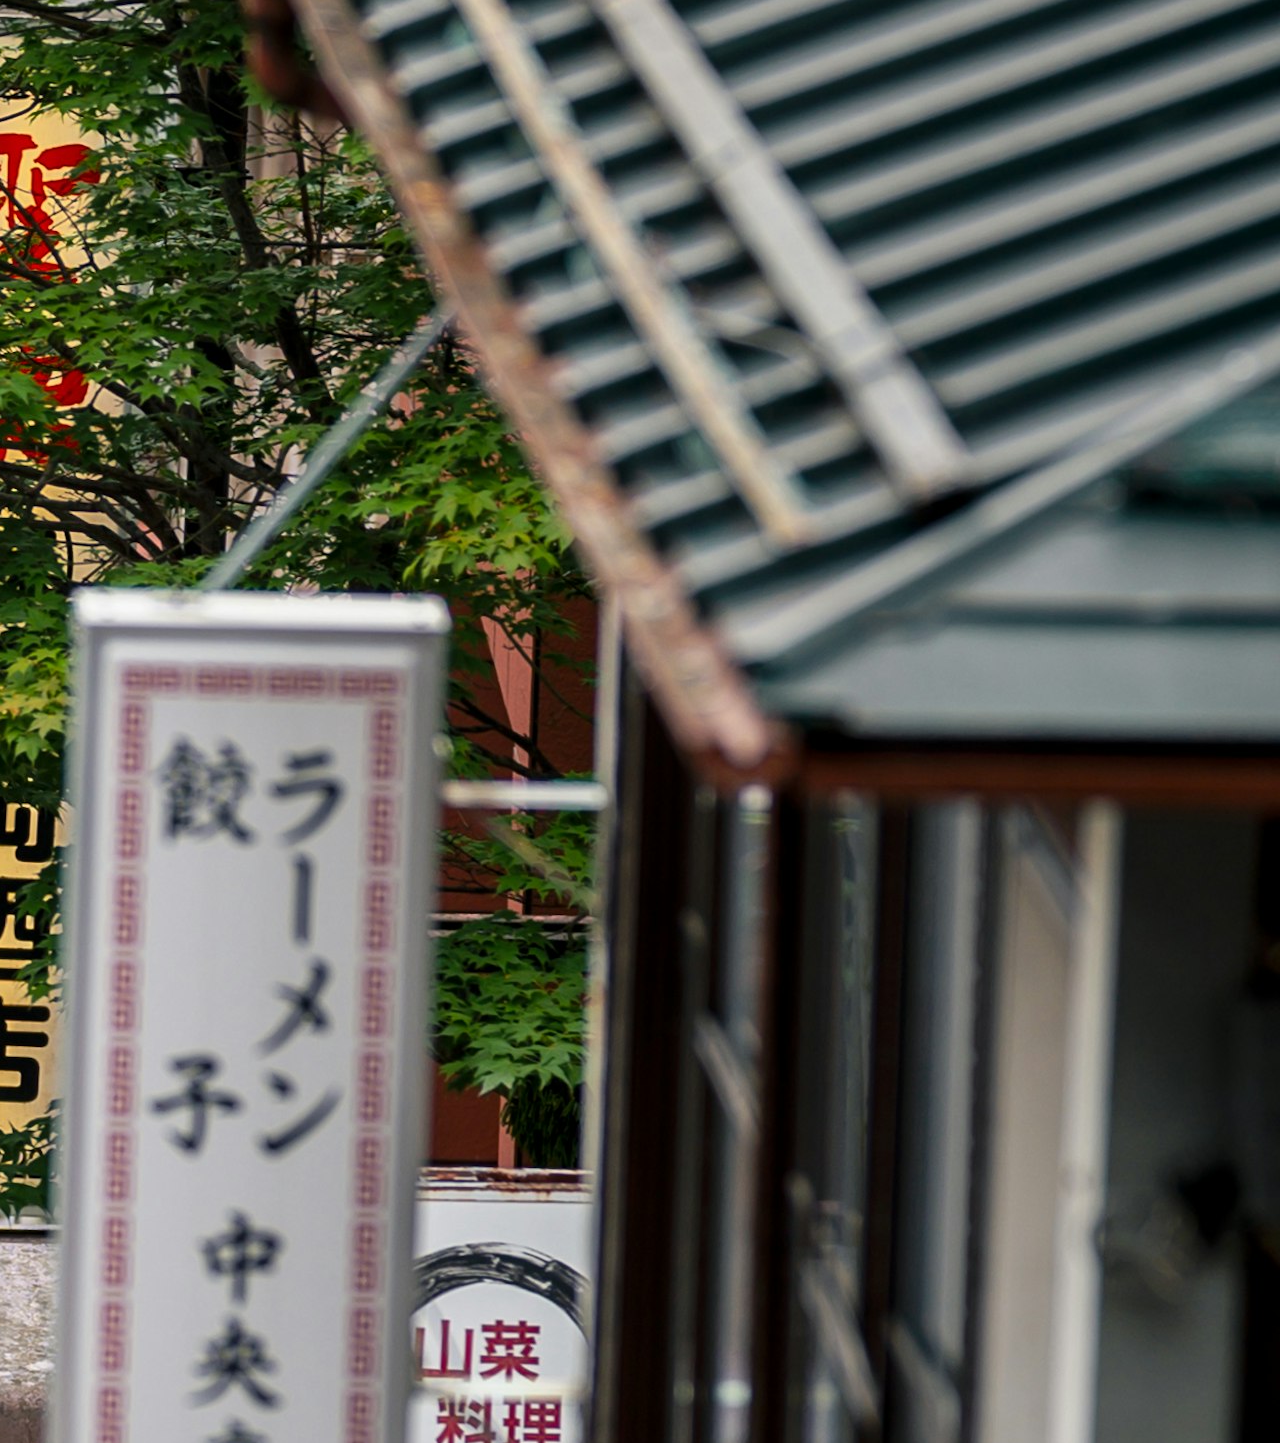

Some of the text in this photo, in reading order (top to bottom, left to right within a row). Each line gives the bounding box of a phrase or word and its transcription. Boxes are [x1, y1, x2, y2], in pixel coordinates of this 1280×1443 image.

[256, 748, 346, 1155] ラーメン
[413, 1320, 541, 1382] 山菜
